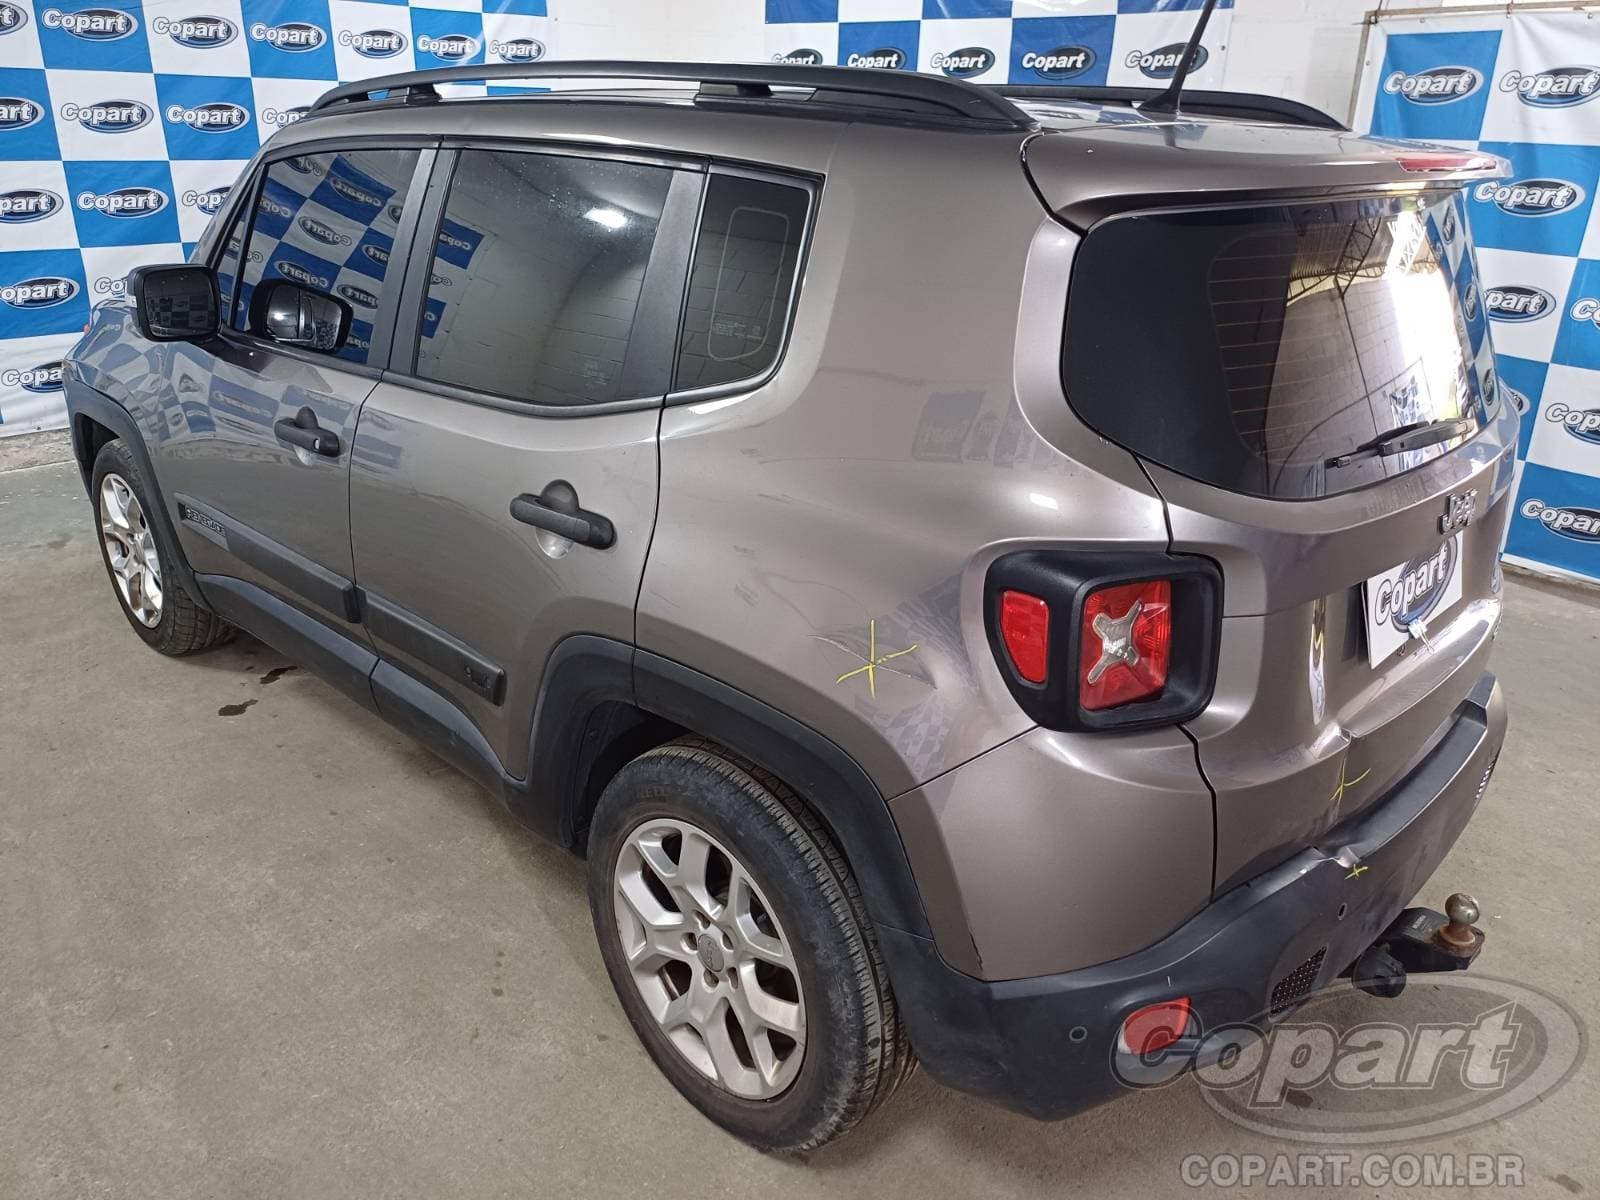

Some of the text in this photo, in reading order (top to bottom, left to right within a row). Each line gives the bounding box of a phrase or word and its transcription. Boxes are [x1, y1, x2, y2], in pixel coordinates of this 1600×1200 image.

[43, 9, 127, 33] Copart
[153, 17, 227, 39] Copart
[251, 23, 318, 45] Copart
[338, 30, 400, 50] Copart
[418, 36, 473, 56] Copart
[489, 40, 539, 57] Copart
[848, 53, 898, 68] Copart
[931, 53, 986, 70] Copart
[1022, 52, 1085, 72] Copart
[1385, 71, 1472, 97] Copart
[1500, 70, 1600, 98] Copart
[61, 103, 141, 126] Copart
[168, 106, 242, 127] Copart
[78, 192, 158, 211] Copart
[1474, 181, 1573, 208] Copart
[0, 281, 68, 304] opart
[1375, 541, 1449, 625] Copart
